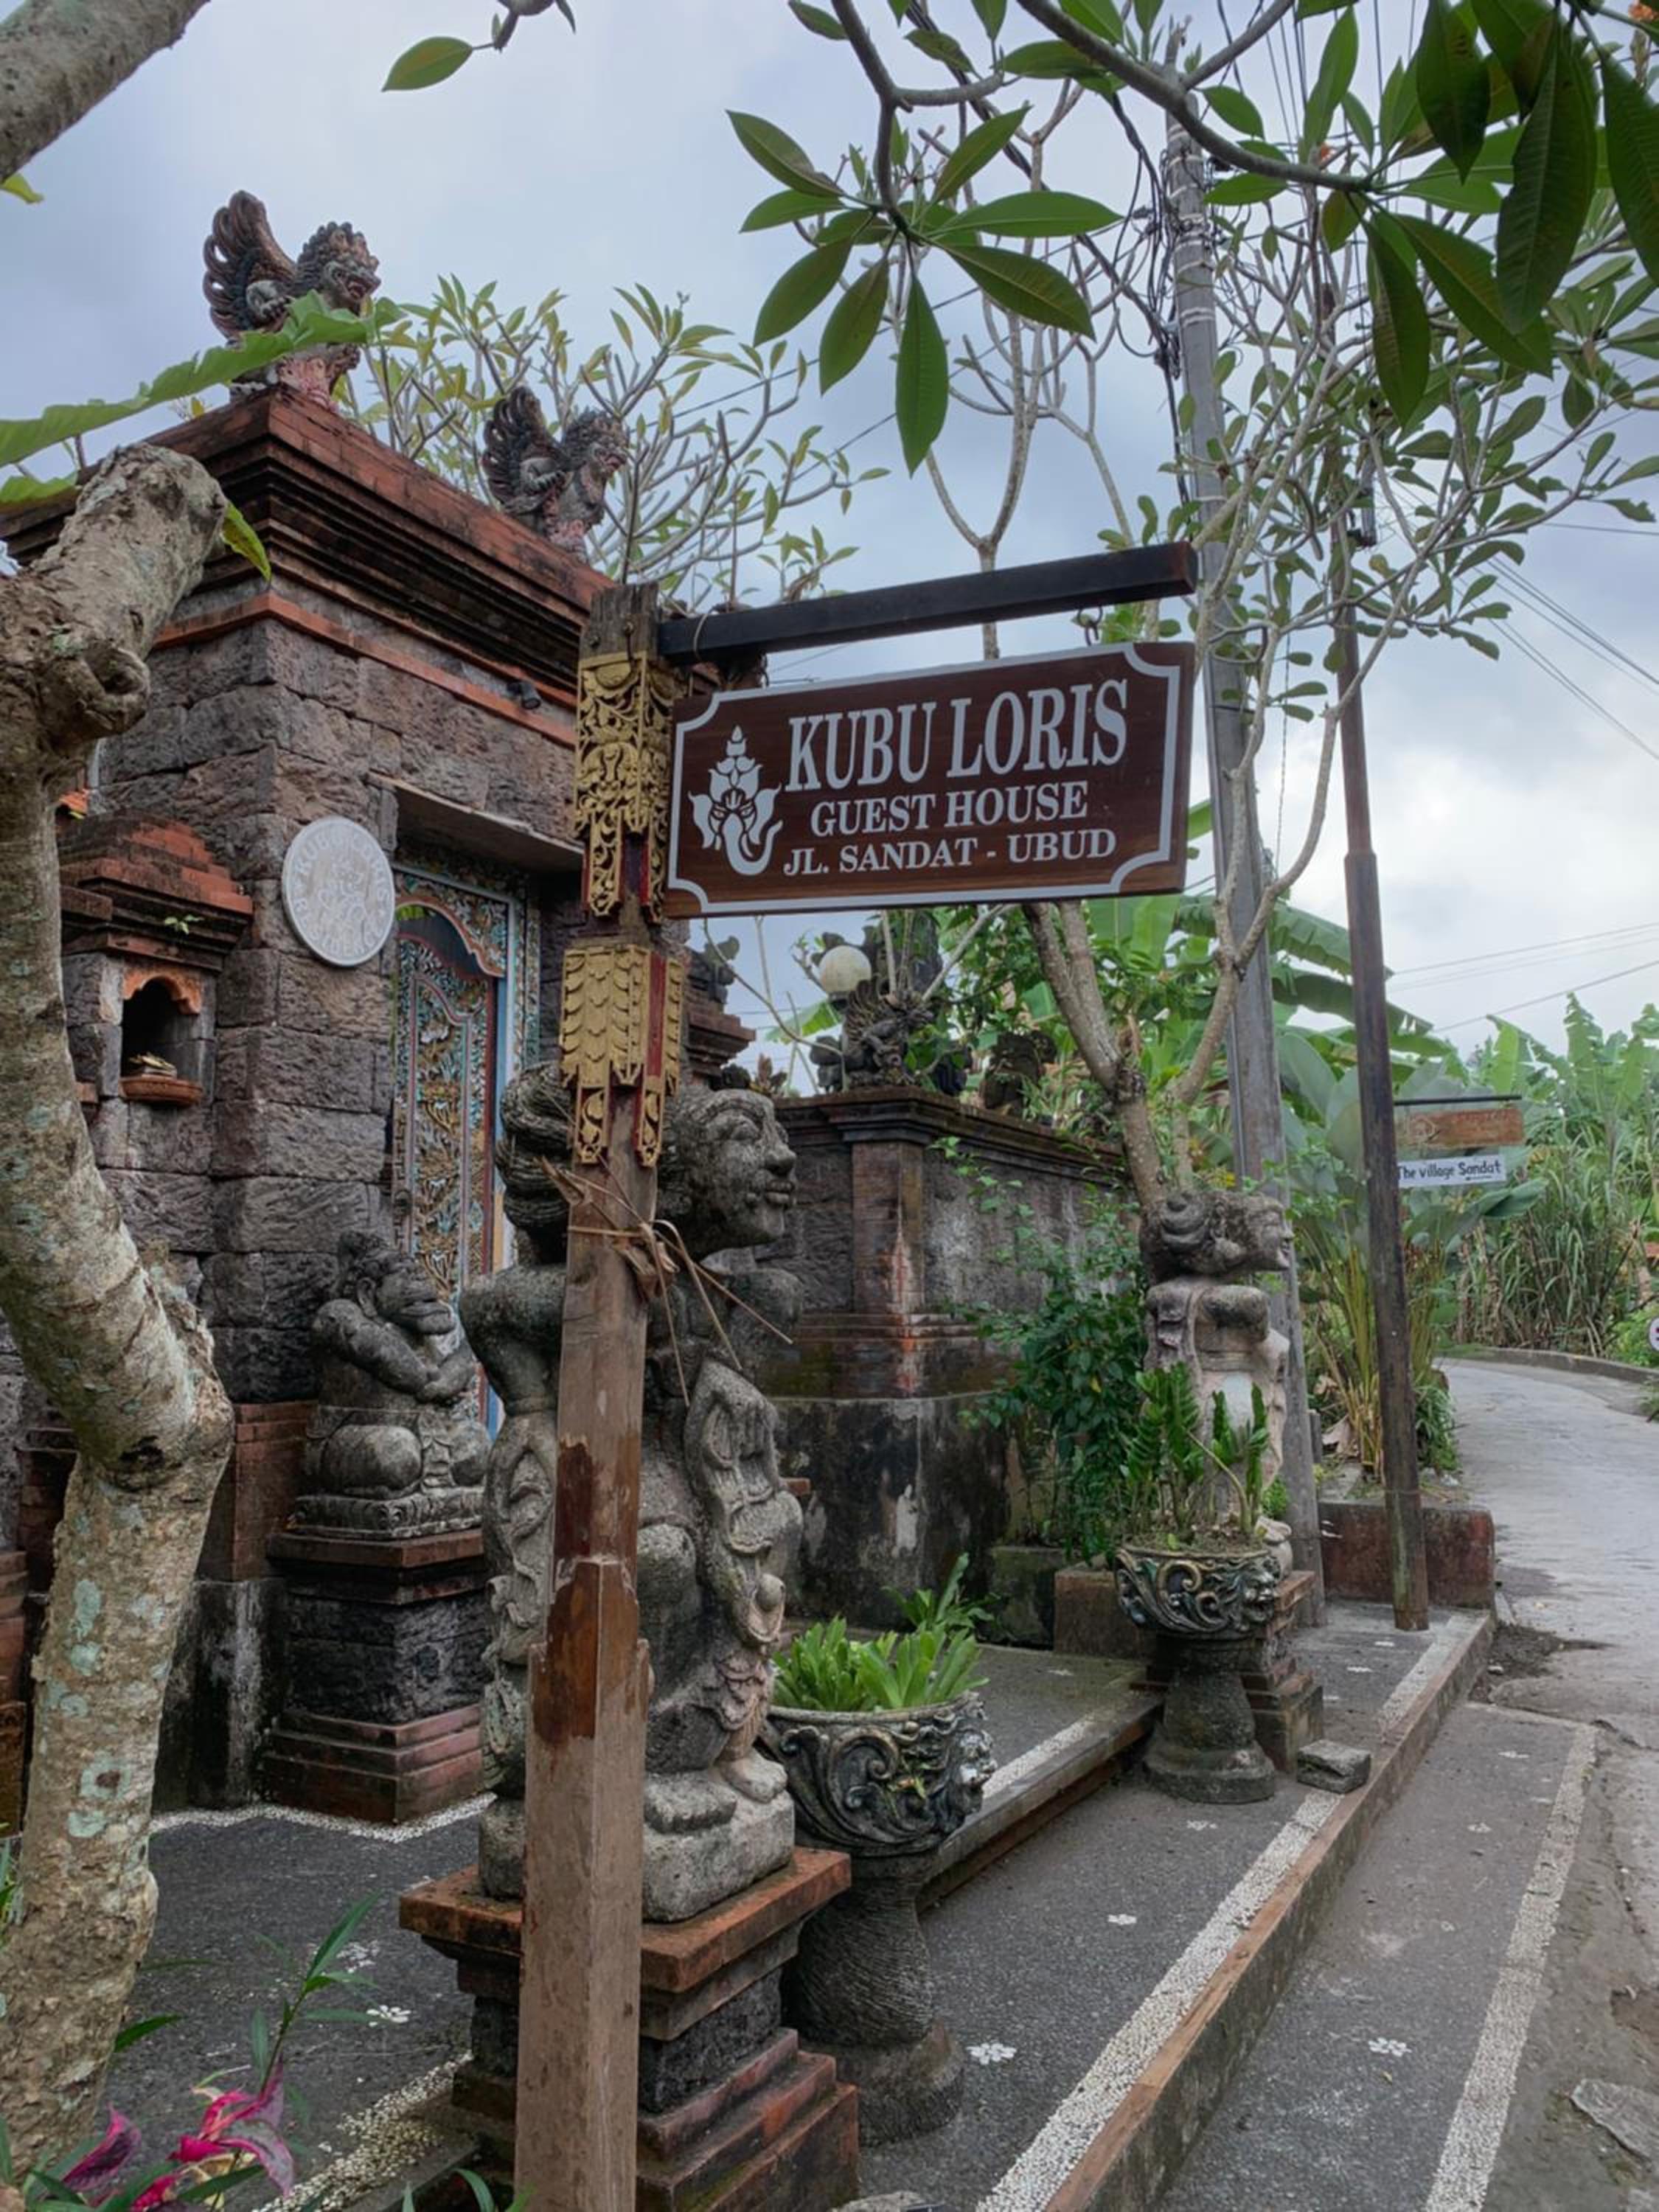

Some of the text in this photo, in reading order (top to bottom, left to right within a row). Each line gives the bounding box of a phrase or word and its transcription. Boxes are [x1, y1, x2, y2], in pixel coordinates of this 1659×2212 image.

[785, 678, 1129, 792] KUBU LORIS
[811, 781, 1088, 837] GUEST HOUSE
[783, 848, 830, 876] JL.
[839, 838, 978, 873] SANDAT
[1007, 829, 1117, 863] UBUD
[1458, 1160, 1500, 1176] Sandat
